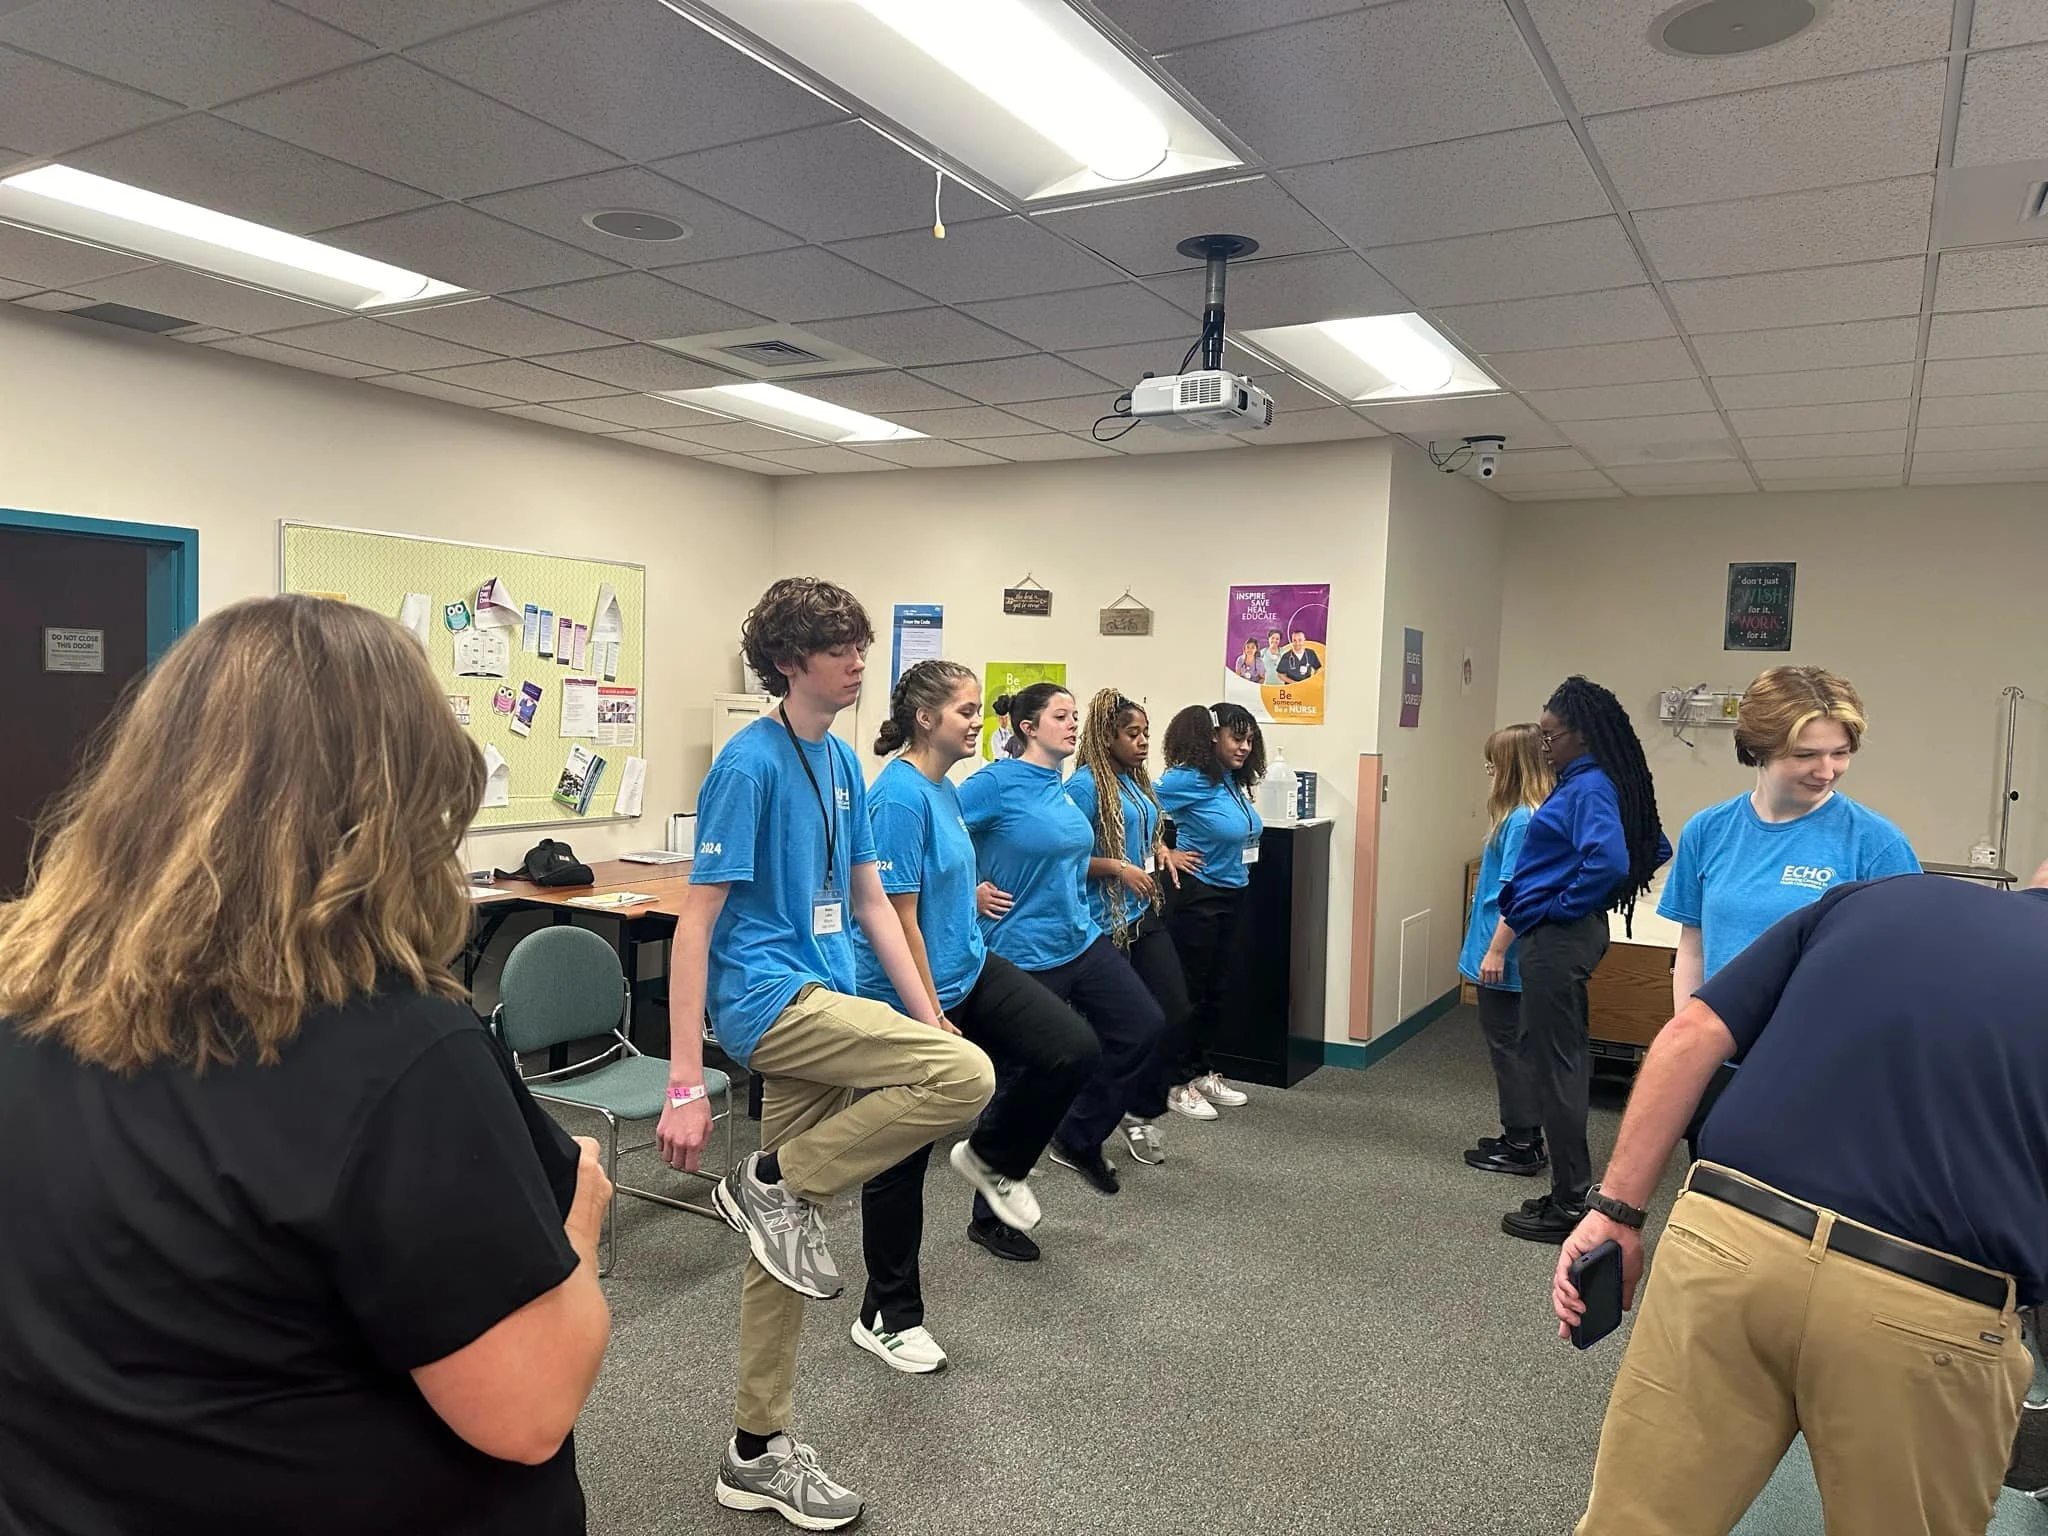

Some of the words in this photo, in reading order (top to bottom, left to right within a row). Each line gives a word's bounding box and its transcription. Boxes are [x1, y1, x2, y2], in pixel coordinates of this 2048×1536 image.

[1741, 577, 1761, 585] don't
[1762, 577, 1779, 586] just
[1237, 592, 1266, 600] INSPIRE
[1251, 599, 1269, 607] SAVE
[1748, 605, 1760, 614] for
[1242, 612, 1277, 620] EDUCATE
[1739, 615, 1780, 630] WORK
[1746, 631, 1758, 639] for
[1760, 631, 1767, 639] it
[1006, 672, 1020, 686] Be
[1279, 689, 1292, 700] Be
[1272, 697, 1302, 706] Someone
[1288, 705, 1317, 714] NURSE
[700, 842, 722, 854] 2024
[875, 860, 893, 871] 024
[1783, 865, 1832, 882] ECHO
[760, 1209, 793, 1235] N
[768, 1470, 799, 1495] N
